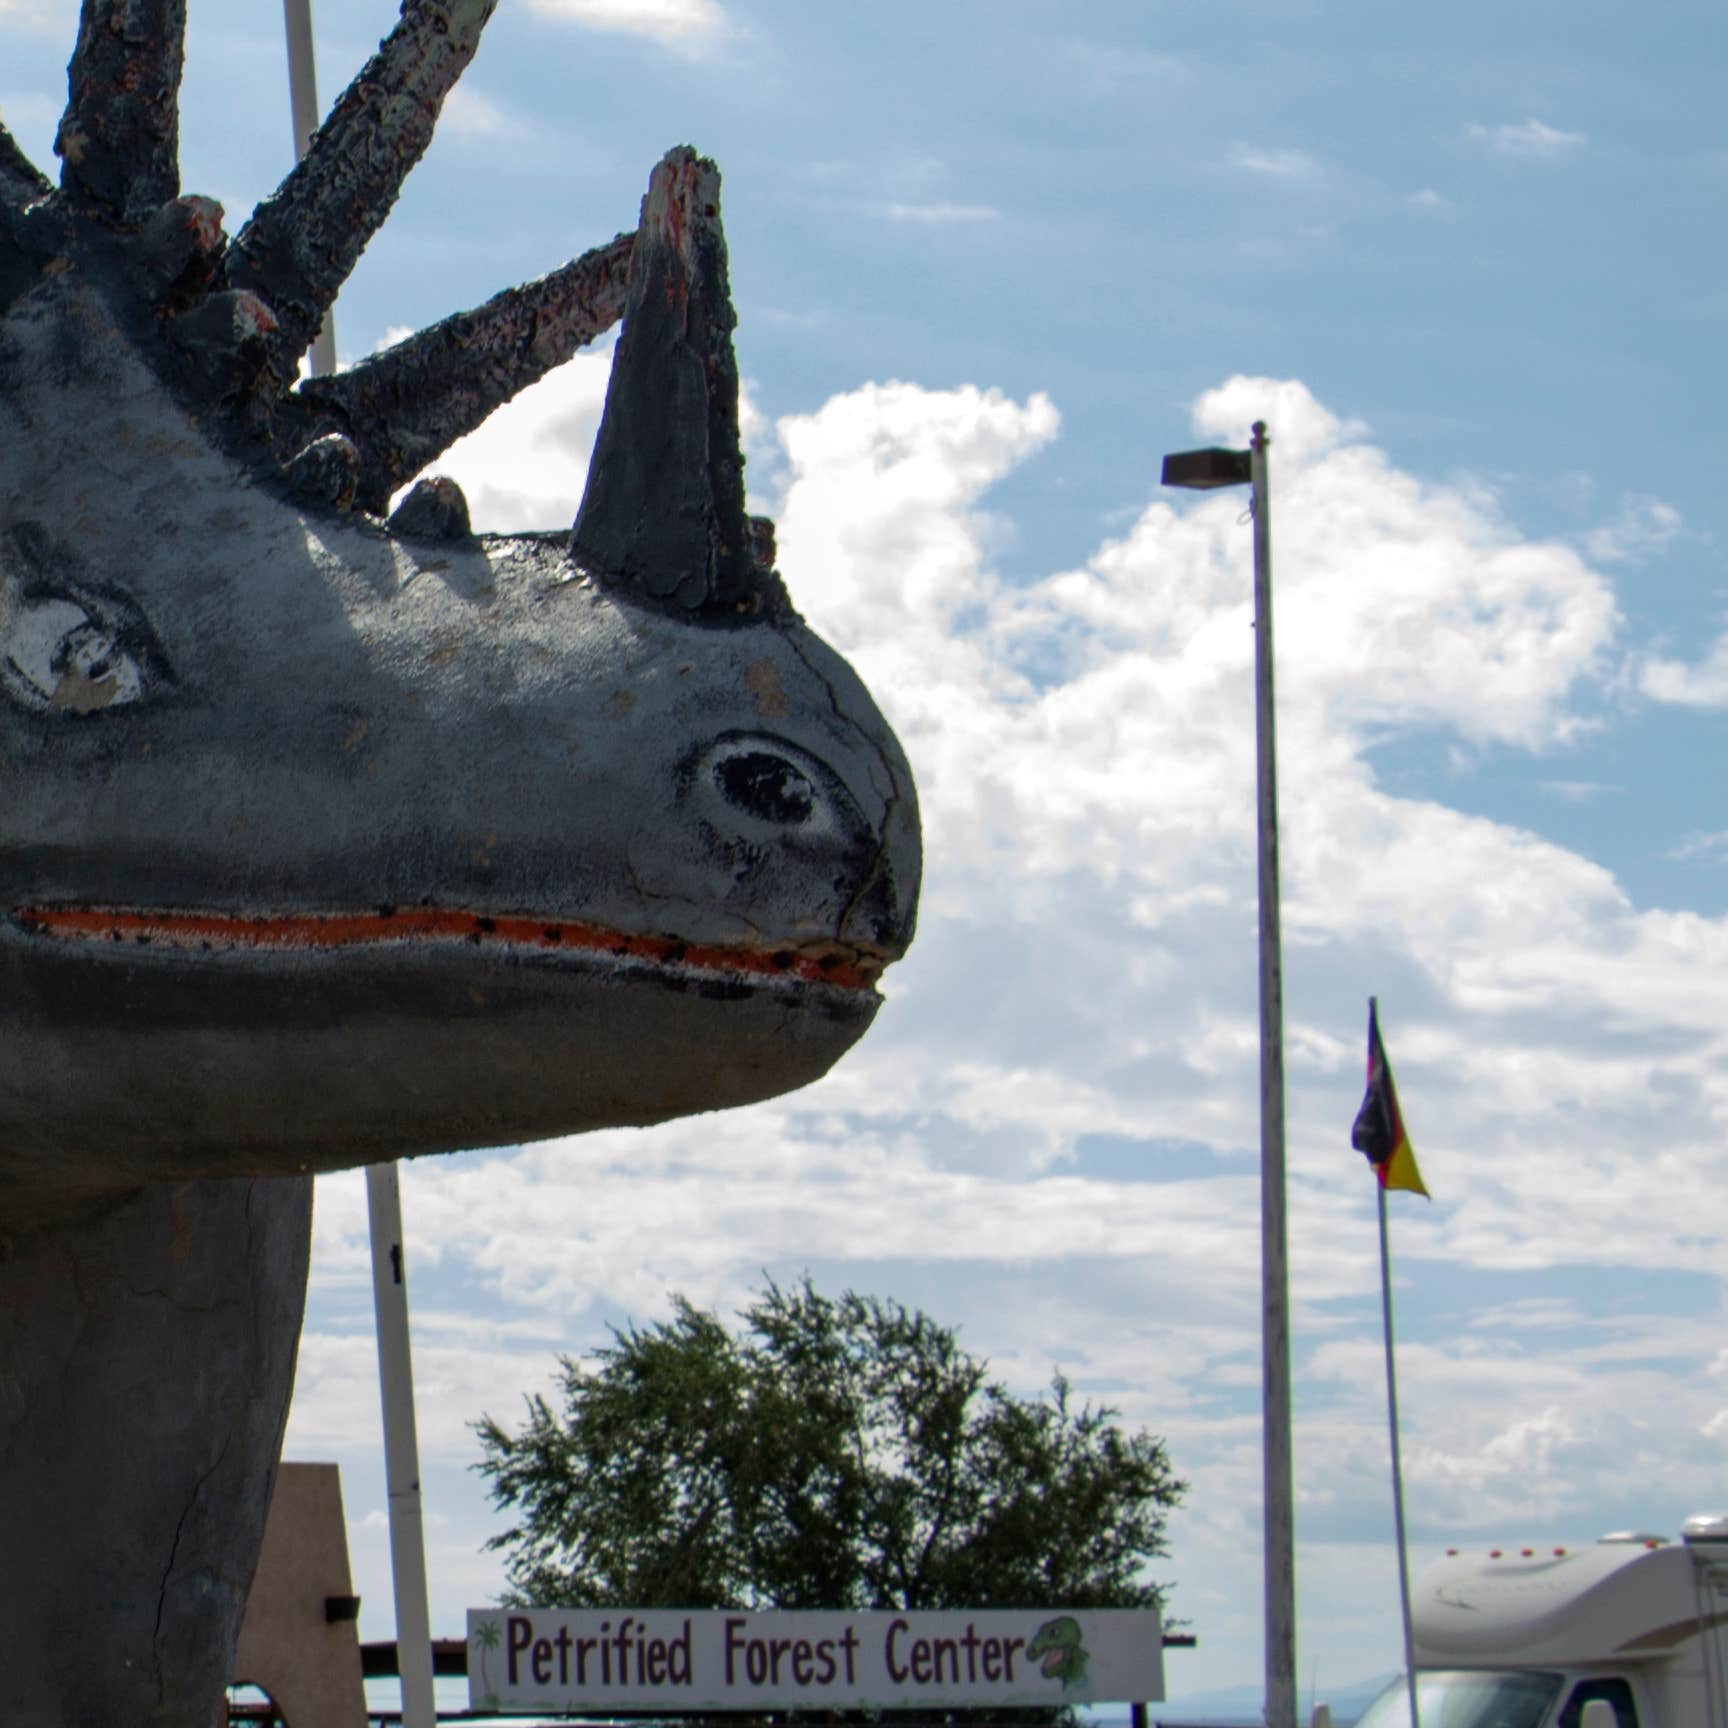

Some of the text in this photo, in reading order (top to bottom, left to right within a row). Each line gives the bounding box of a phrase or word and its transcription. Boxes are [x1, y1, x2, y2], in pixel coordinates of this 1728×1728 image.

[506, 1616, 1025, 1687] Petrified Forest Center
